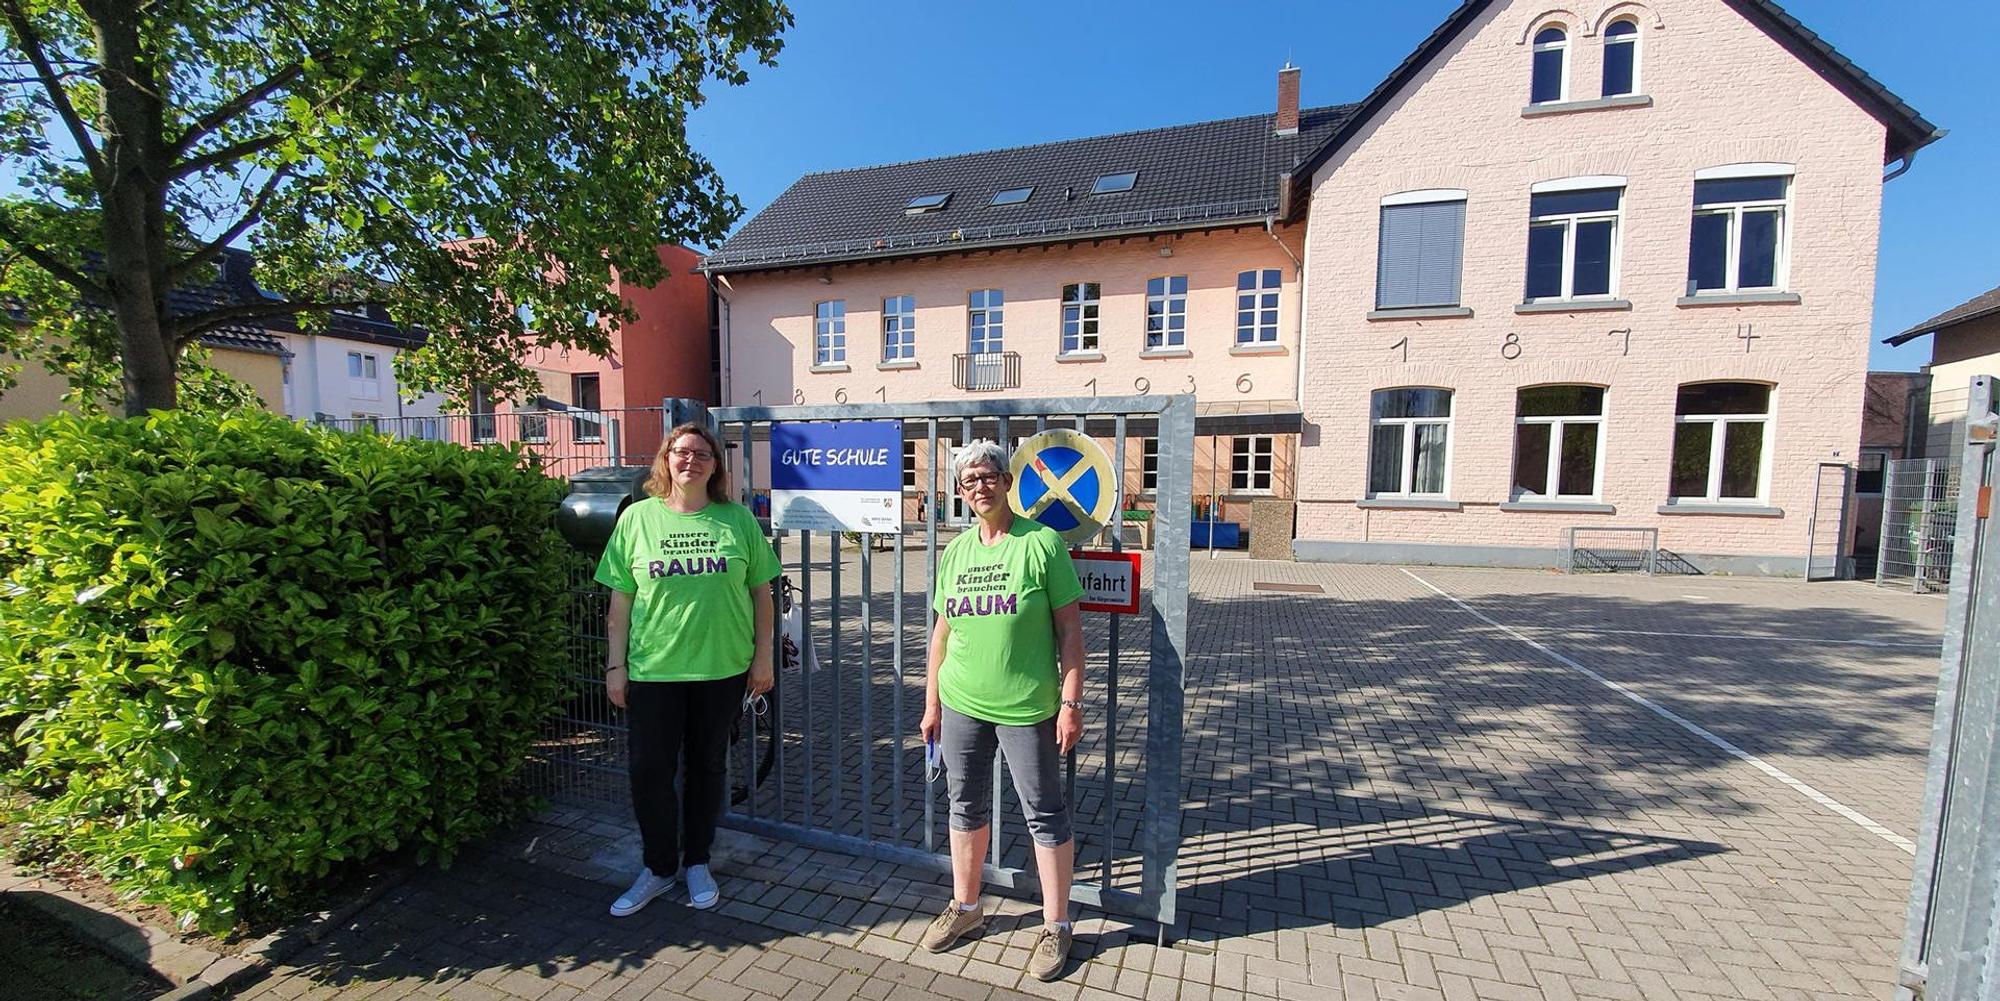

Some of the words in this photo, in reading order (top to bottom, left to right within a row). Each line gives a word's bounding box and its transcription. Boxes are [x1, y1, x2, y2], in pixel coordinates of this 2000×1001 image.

[1391, 323, 1761, 362] 1874
[1084, 373, 1254, 397] 1936
[753, 385, 886, 406] 1861
[781, 448, 823, 466] GUTE
[826, 448, 889, 466] SCHULE
[660, 538, 718, 549] Kinder
[669, 531, 709, 539] unsere
[663, 547, 716, 556] brauchen
[649, 556, 728, 579] RAUM
[967, 563, 1004, 574] unsere
[956, 572, 1010, 586] Kinder
[1078, 572, 1126, 592] ufahrt
[957, 583, 1006, 594] brauchen
[946, 593, 1017, 619] RAUM
